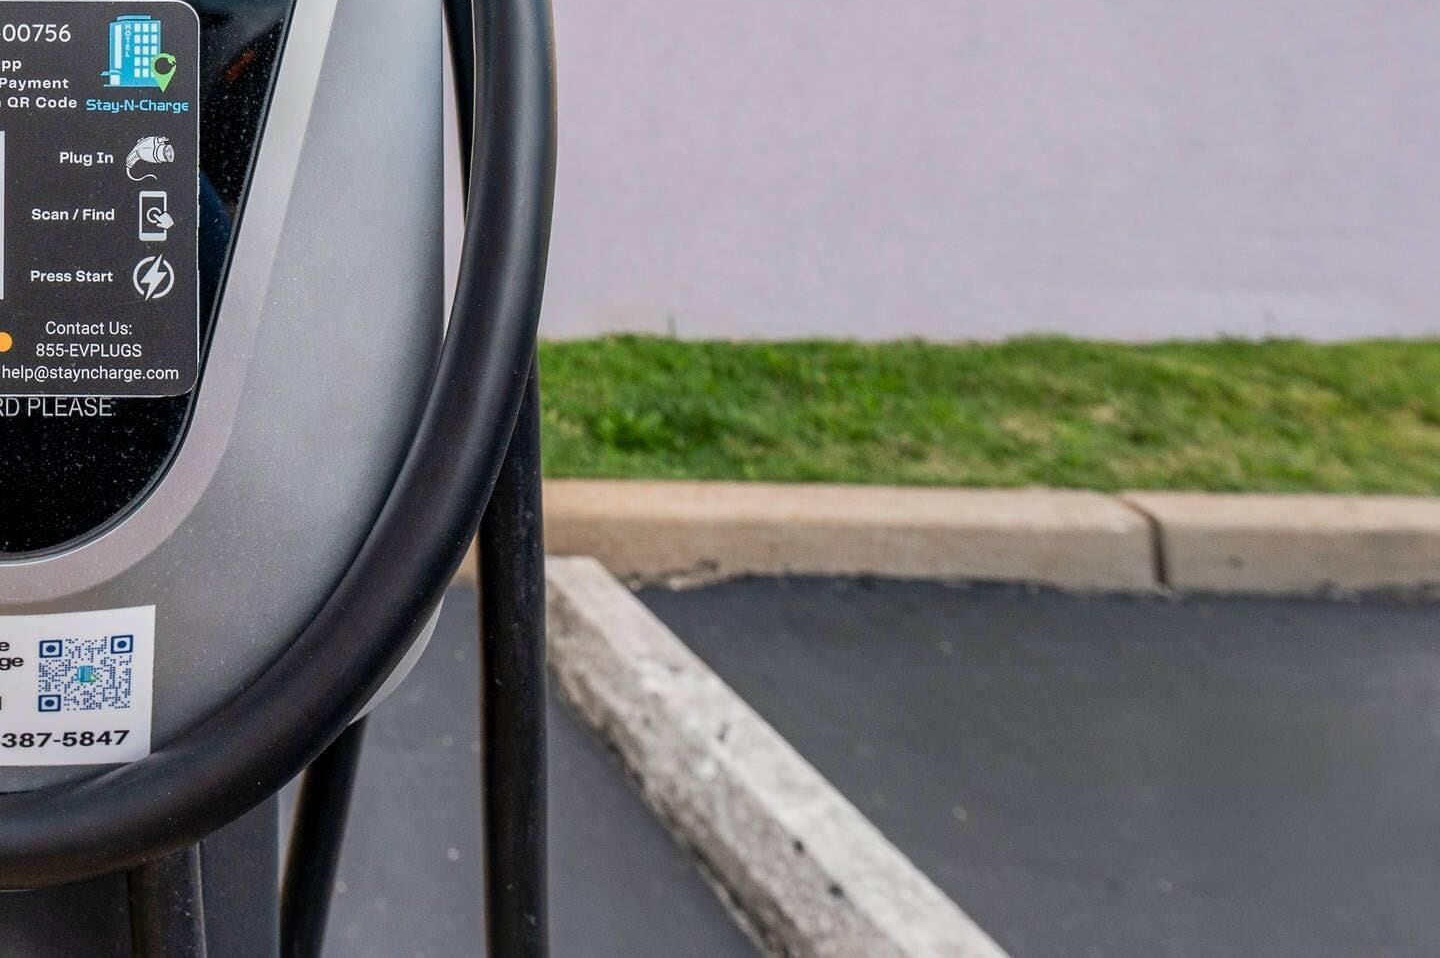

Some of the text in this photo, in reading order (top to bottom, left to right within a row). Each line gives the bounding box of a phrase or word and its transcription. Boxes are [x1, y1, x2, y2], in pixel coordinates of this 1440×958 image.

[8, 97, 30, 109] QR
[36, 97, 78, 109] Code
[86, 99, 189, 113] Stay-N-Charge
[60, 152, 113, 167] Plug In
[32, 209, 67, 221] Scan
[83, 208, 115, 221] Find
[31, 270, 113, 282] Press Start
[45, 321, 132, 335] Contact Us:
[36, 343, 142, 357] 855-EVPLUGS
[2, 365, 179, 382] help@stayncharge.com
